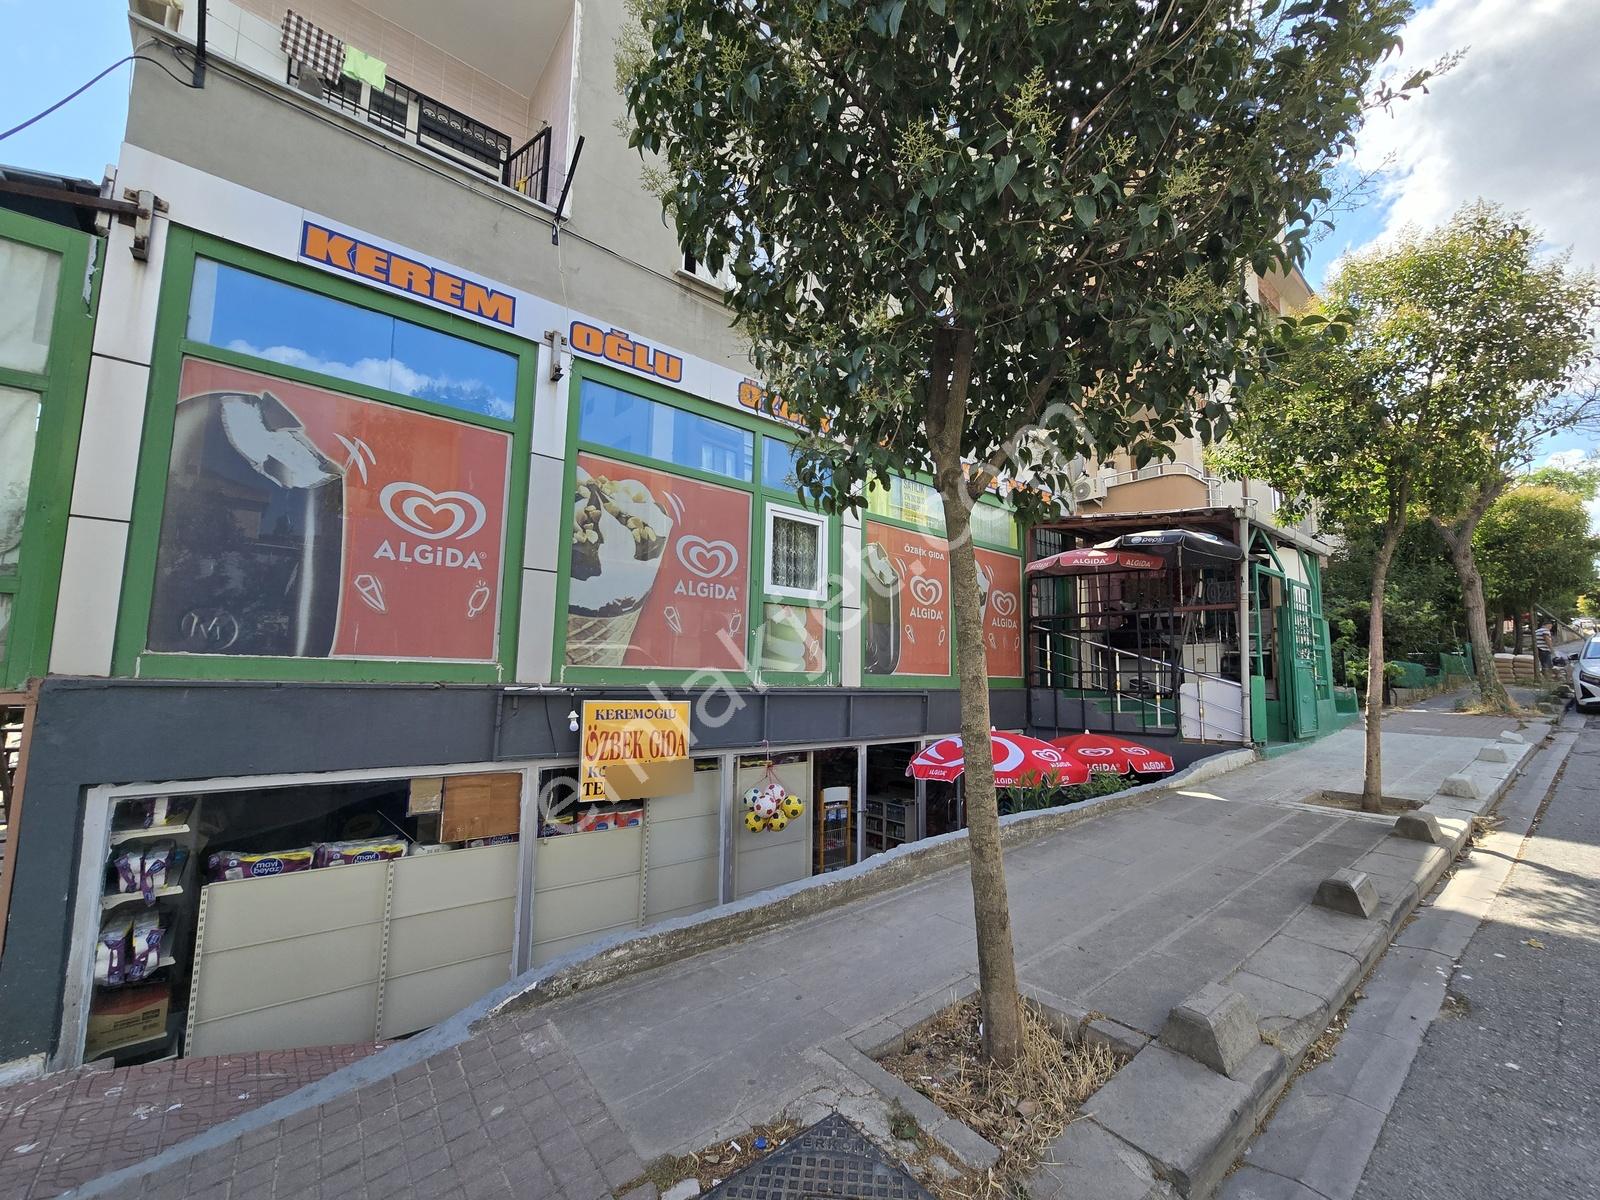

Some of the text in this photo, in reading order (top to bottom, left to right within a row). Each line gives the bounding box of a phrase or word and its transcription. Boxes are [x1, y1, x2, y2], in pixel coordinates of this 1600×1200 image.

[301, 221, 515, 328] KEREM
[570, 321, 682, 383] OĞLU
[1142, 536, 1164, 544] pepsi
[904, 544, 945, 561] ÖZBEK GIDA
[586, 724, 686, 761] ÖZBEK GIDA
[1143, 761, 1166, 771] ALGIDA
[357, 853, 376, 861] mavi
[256, 860, 279, 869] mavi
[254, 866, 280, 875] beyaz
